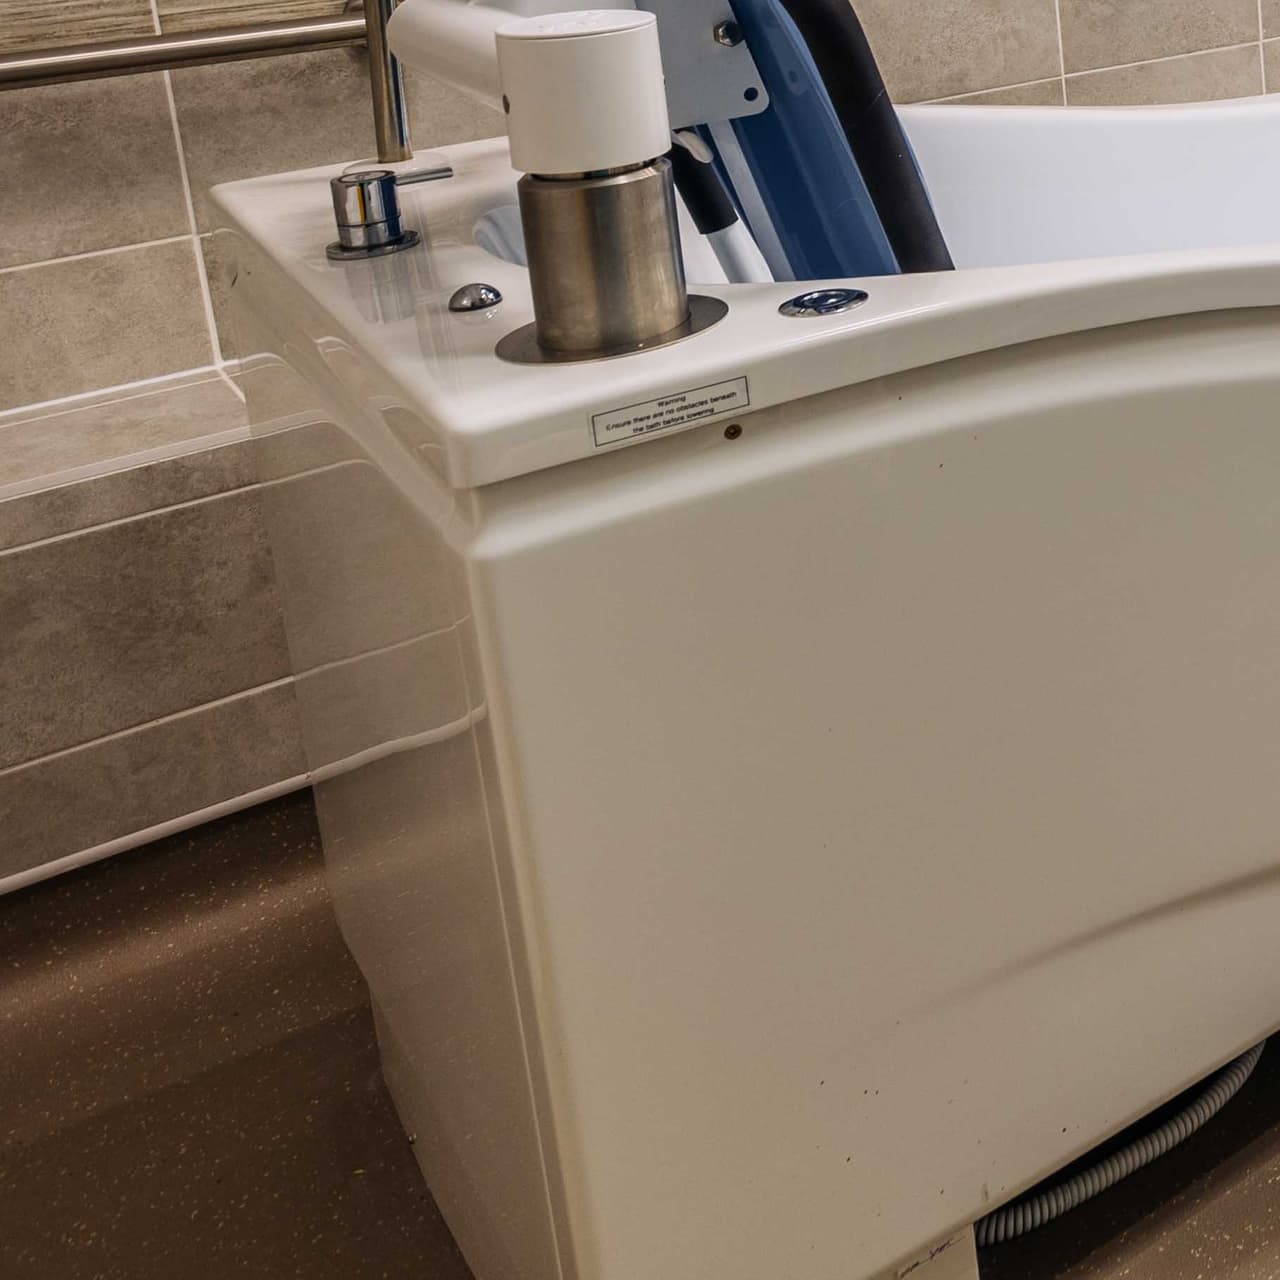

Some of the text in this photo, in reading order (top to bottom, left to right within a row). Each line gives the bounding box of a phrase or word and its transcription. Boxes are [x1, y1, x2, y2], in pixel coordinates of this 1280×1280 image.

[606, 391, 737, 431] Ensure there are no obstacles beneath
[657, 395, 686, 407] Warning
[632, 407, 715, 434] the bath before lowering
